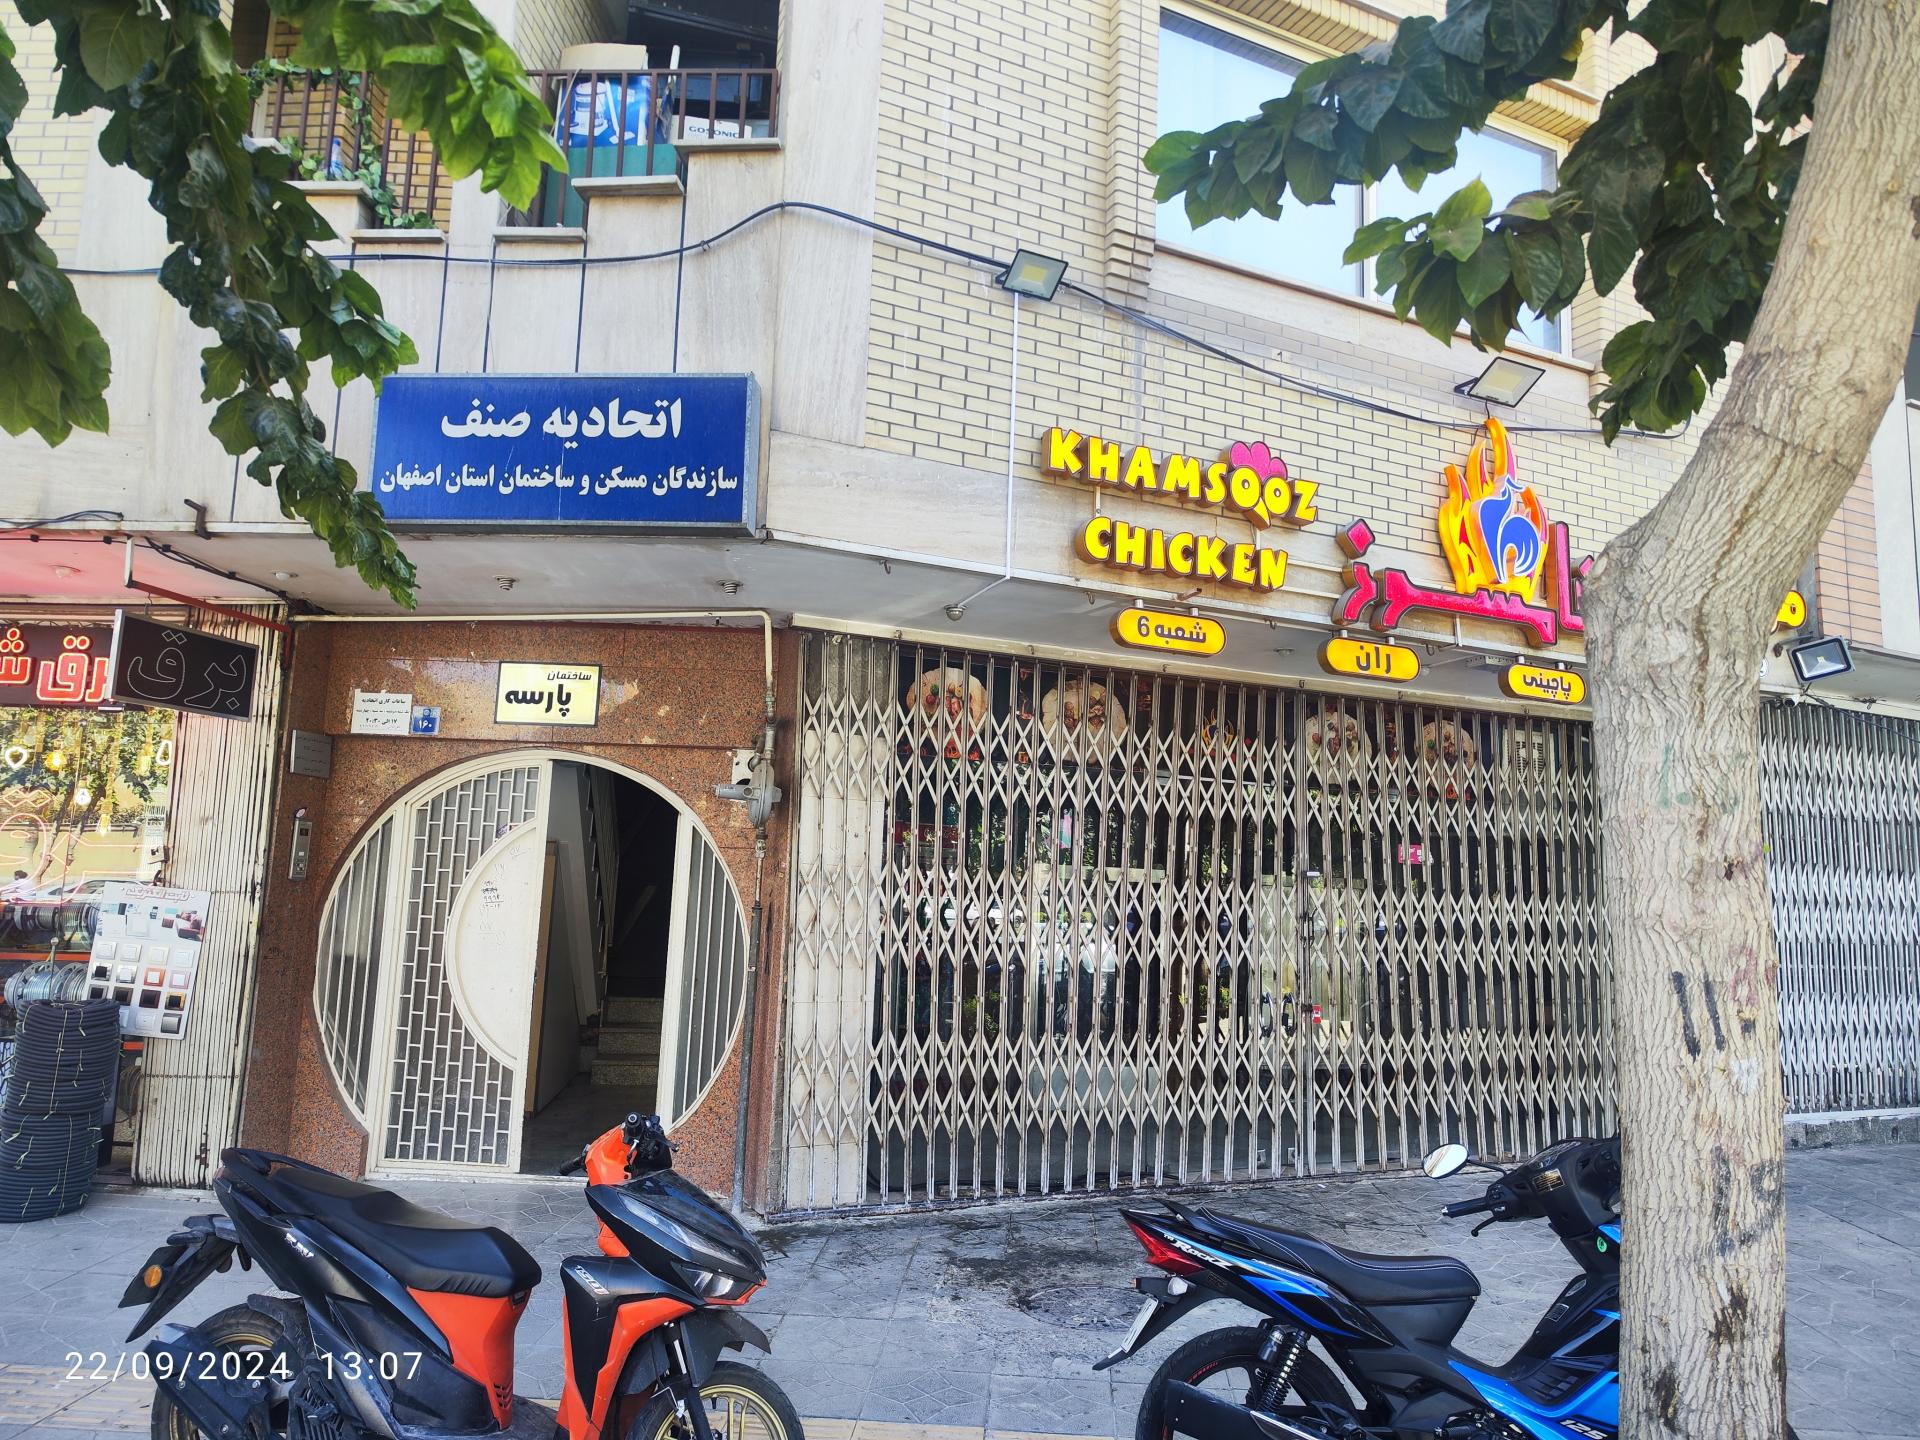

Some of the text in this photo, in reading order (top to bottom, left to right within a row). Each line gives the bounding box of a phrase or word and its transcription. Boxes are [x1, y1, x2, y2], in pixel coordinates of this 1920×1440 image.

[441, 397, 682, 448] اتحادیه صنف
[379, 463, 738, 497] سازندگان مسکن و ساختمان استان اصفهان
[1048, 426, 1320, 526] KHAMSOOZ
[1083, 516, 1288, 592] CHICKEN
[1137, 615, 1206, 645] شعبه 6
[35, 635, 110, 702] رق
[127, 630, 247, 710] برق
[547, 671, 592, 681] ساختمان
[1356, 645, 1391, 674] ران
[505, 684, 571, 717] پارسه
[1522, 672, 1572, 700] پاچینی
[1560, 1419, 1608, 1440] 125
